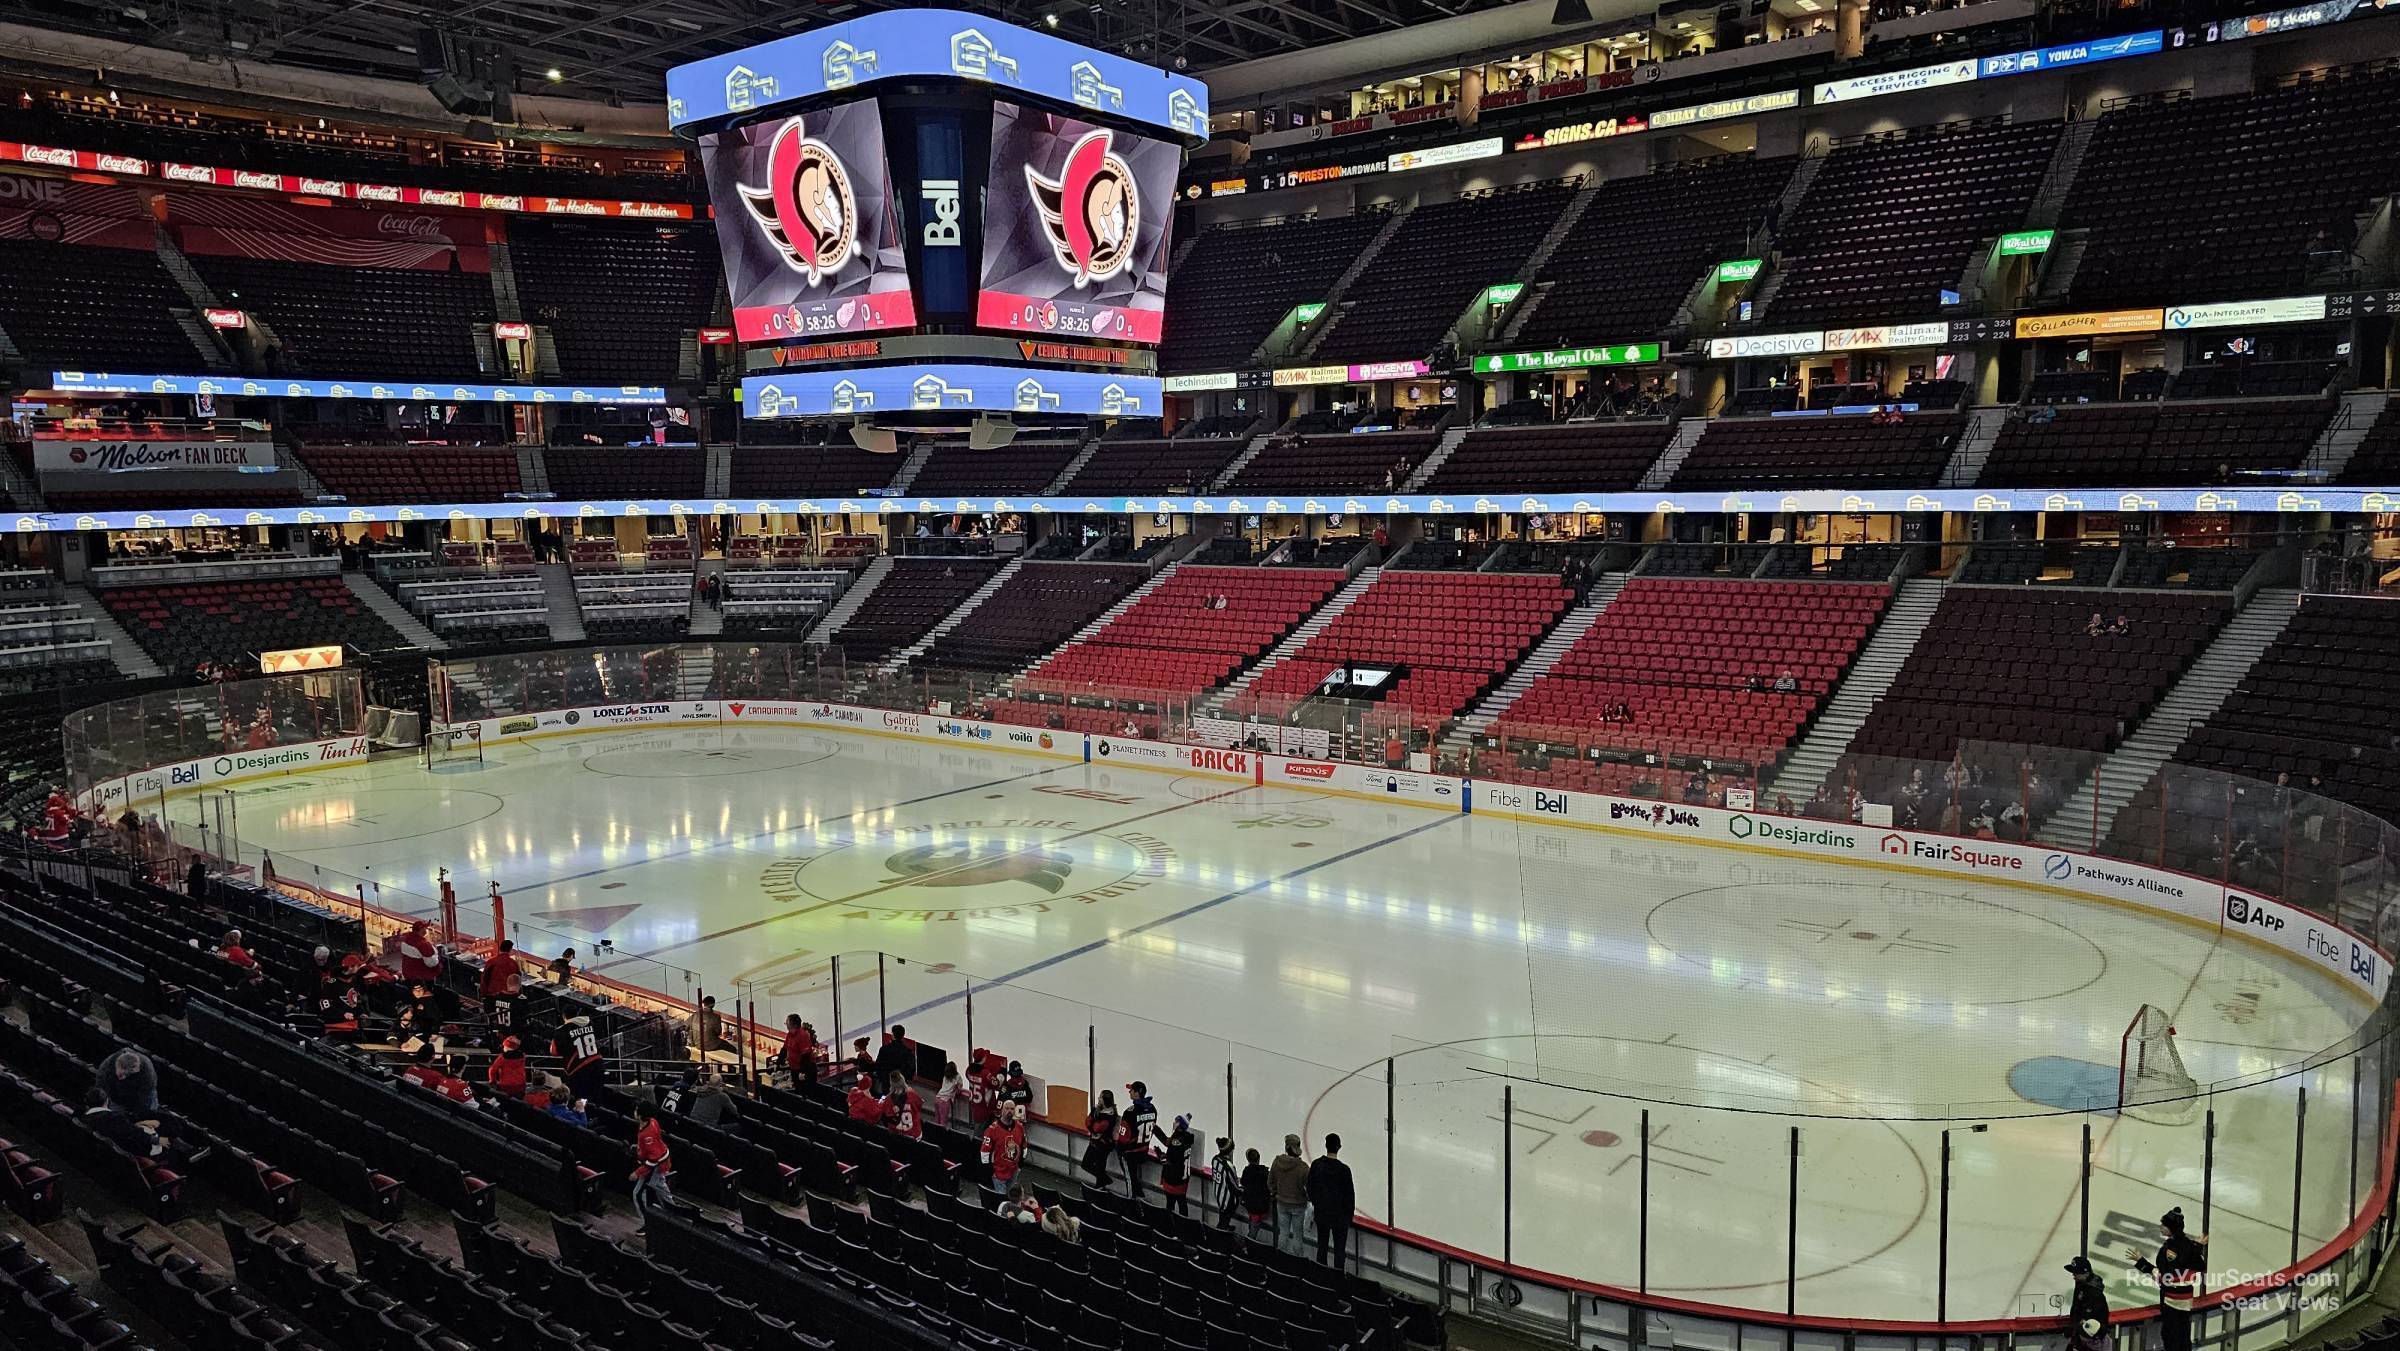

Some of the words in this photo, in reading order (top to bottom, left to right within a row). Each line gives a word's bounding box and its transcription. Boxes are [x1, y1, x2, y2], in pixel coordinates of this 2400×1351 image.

[2282, 10, 2321, 26] skate
[2048, 47, 2087, 63] YOW.CA
[1851, 75, 1894, 88] ACCESS
[1898, 66, 1950, 80] RIGGING
[1871, 78, 1928, 94] SERVICES
[1544, 118, 1618, 146] SIGNS.CA
[545, 199, 566, 214] Tim
[566, 200, 606, 216] Hortons
[620, 202, 640, 216] Tim
[640, 203, 678, 217] Hortons
[924, 180, 962, 246] Bell
[378, 213, 446, 236] Coca-Cola
[2332, 295, 2352, 304] 324
[1024, 304, 1034, 322] 0
[2331, 307, 2352, 316] 224
[772, 313, 782, 330] 0
[806, 314, 836, 332] 58:26
[1060, 316, 1090, 332] 58:26
[1116, 314, 1124, 332] 0
[1888, 324, 1945, 336] Hallmark
[1953, 322, 1970, 330] 323
[1994, 319, 2011, 328] 324
[2030, 318, 2096, 333] GALLAGHER
[1828, 329, 1883, 348] RE/MAX
[1888, 335, 1916, 346] Realty
[1918, 334, 1946, 344] Group
[1952, 333, 1970, 342] 223
[1992, 330, 2010, 339] 224
[1736, 334, 1814, 355] Decisive
[1516, 354, 1541, 368] The
[1544, 350, 1580, 367] Royal
[1582, 348, 1611, 362] Oak
[1371, 361, 1415, 374] MAGENTA
[1174, 376, 1228, 388] TechInsights
[1274, 370, 1310, 386] RE/MAX
[90, 444, 182, 469] Molson
[185, 450, 210, 464] FAN
[214, 447, 248, 464] DECK
[593, 708, 625, 718] LONE
[640, 704, 670, 714] STAR
[748, 706, 782, 715] CANADIAN
[784, 707, 798, 716] TIRE
[835, 710, 863, 723] CANADIAN
[883, 712, 920, 728] Gabriel
[1009, 732, 1033, 743] voilà
[318, 741, 347, 761] Tim
[1112, 744, 1137, 756] PLANET
[1138, 748, 1166, 758] FITNESS
[237, 750, 310, 770] Desjardins
[1176, 748, 1190, 759] The
[1191, 750, 1248, 774] BRICK
[172, 764, 200, 784] Bell
[1366, 774, 1382, 784] Ford
[136, 776, 162, 794] Fibe
[1490, 790, 1520, 808] Fibe
[1536, 792, 1567, 814] Bell
[1610, 802, 1652, 820] Booster
[1666, 810, 1700, 828] Juice
[1759, 822, 1854, 850] Desjardins
[1914, 840, 2022, 870] FairSquare
[2078, 866, 2134, 886] Pathways
[2138, 878, 2184, 898] Alliance
[2307, 928, 2339, 962] Fibe
[2350, 942, 2376, 986] Bell
[573, 1033, 598, 1059] 18
